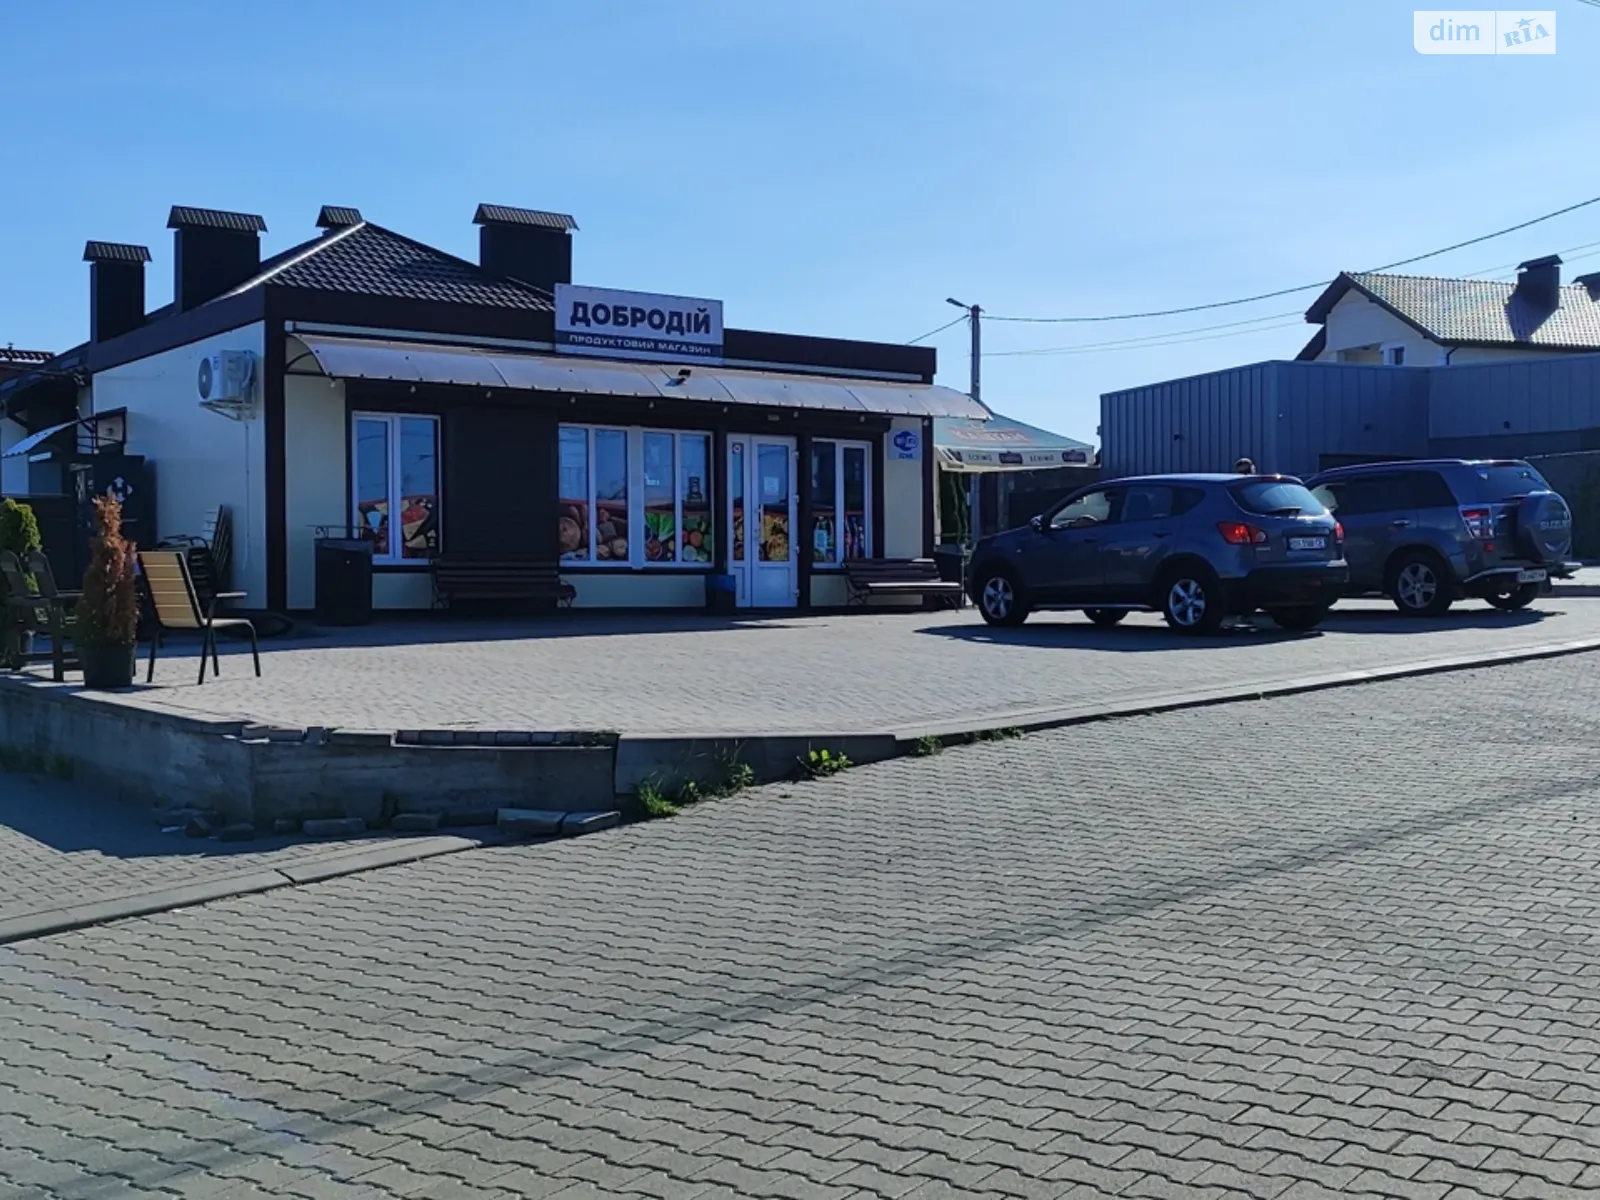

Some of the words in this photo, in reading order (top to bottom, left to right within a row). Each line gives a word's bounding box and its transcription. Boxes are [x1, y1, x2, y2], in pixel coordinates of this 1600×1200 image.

[570, 301, 711, 335] ДОБРОДІЙ
[569, 334, 655, 349] ПРОДУКТОВИЙ
[658, 343, 711, 354] МАГАЗИН
